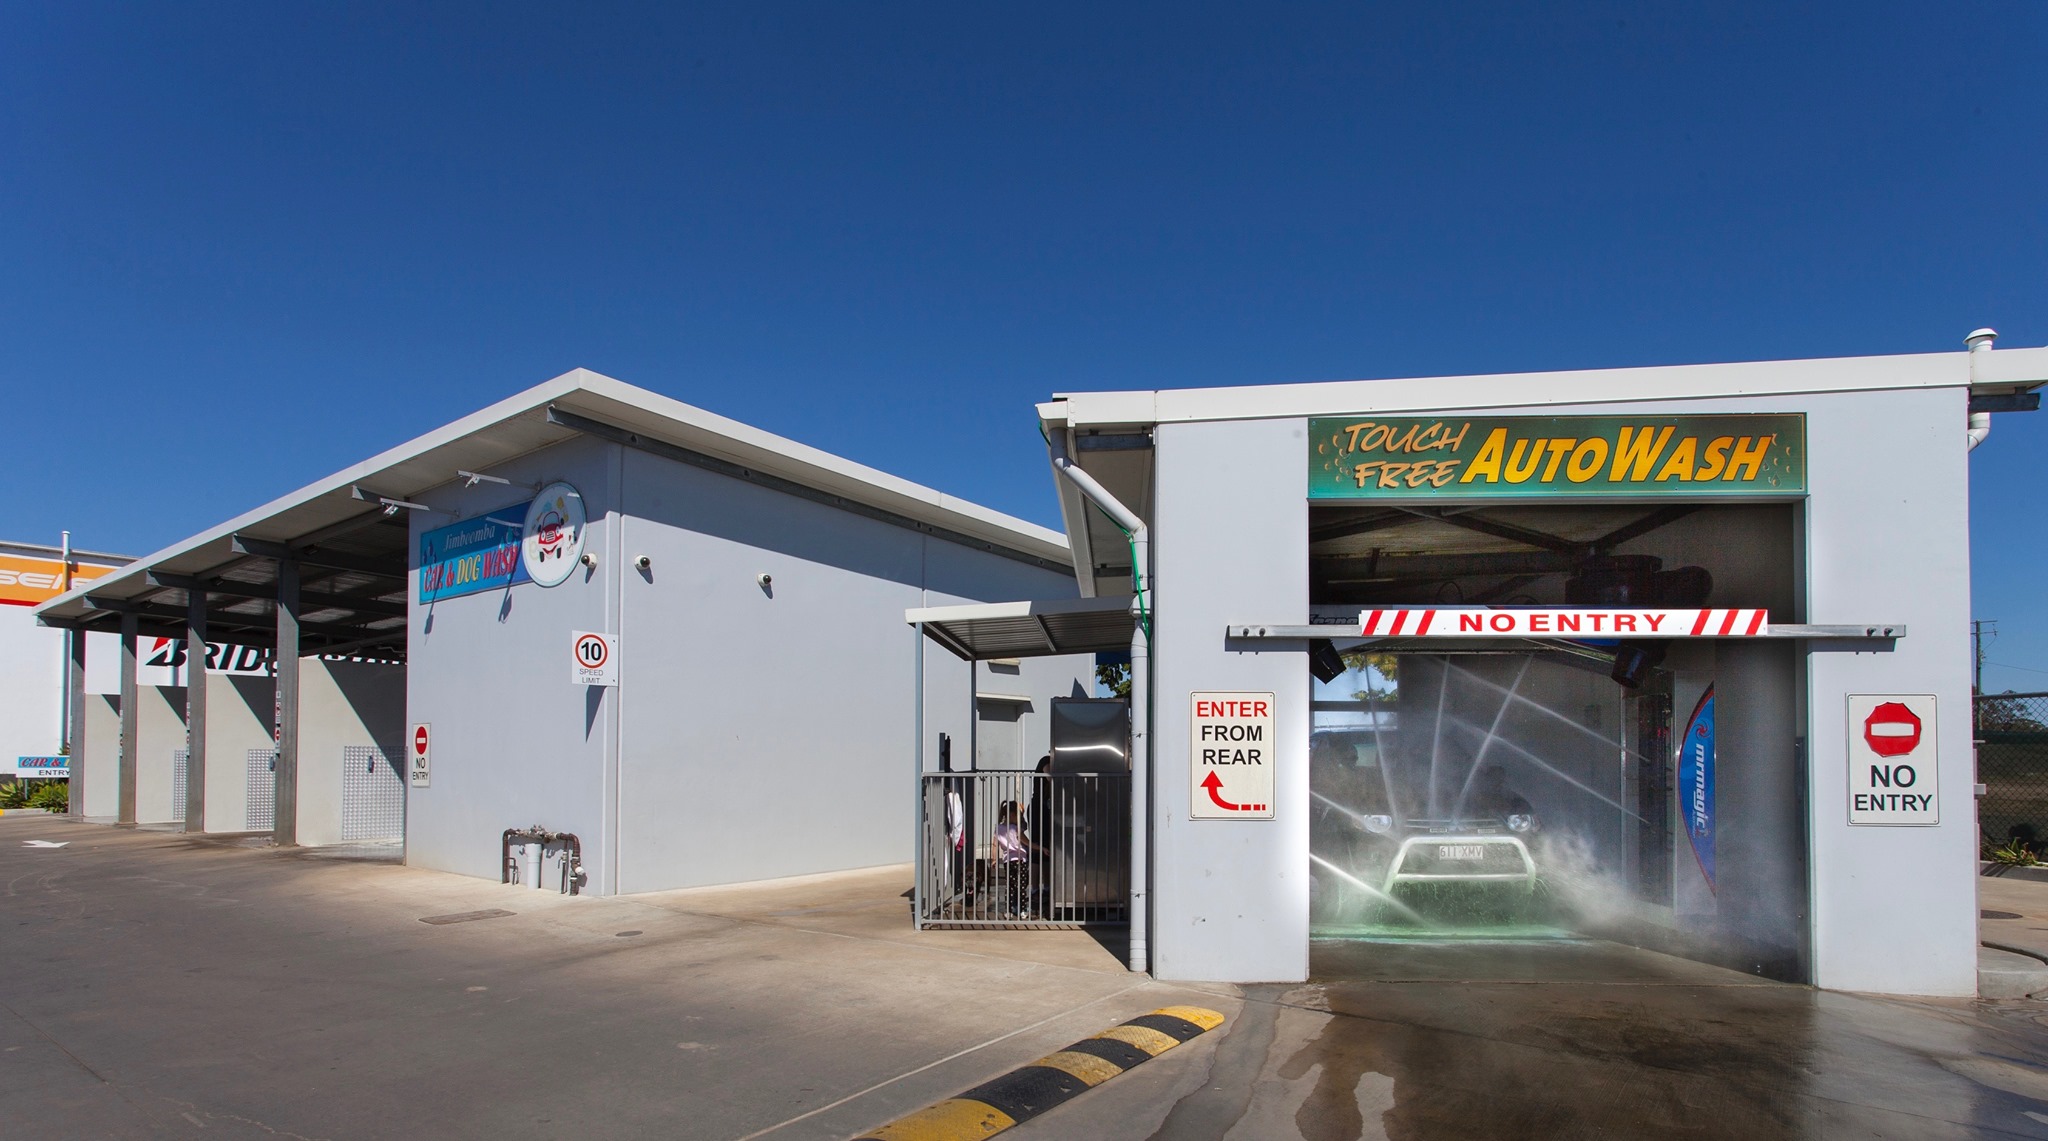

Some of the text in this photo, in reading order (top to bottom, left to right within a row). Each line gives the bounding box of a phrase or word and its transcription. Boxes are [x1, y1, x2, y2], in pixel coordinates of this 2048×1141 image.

[1344, 421, 1471, 453] TOUCH
[1353, 459, 1463, 489] FREE
[443, 523, 496, 551] Jimboomba
[424, 545, 519, 593] CAR & DOG WASH
[1459, 613, 1667, 632] NO ENTRY
[581, 641, 602, 661] 10
[579, 668, 604, 677] SPEED
[1196, 701, 1268, 717] ENTER
[1201, 725, 1263, 741] FROM
[21, 757, 48, 767] CAR
[51, 757, 61, 767] &
[415, 757, 426, 769] NO
[1202, 749, 1262, 765] REAR
[412, 771, 429, 780] ENTRY
[1870, 764, 1916, 788] NO
[1854, 794, 1933, 811] ENTRY
[1461, 846, 1482, 857] XMV
